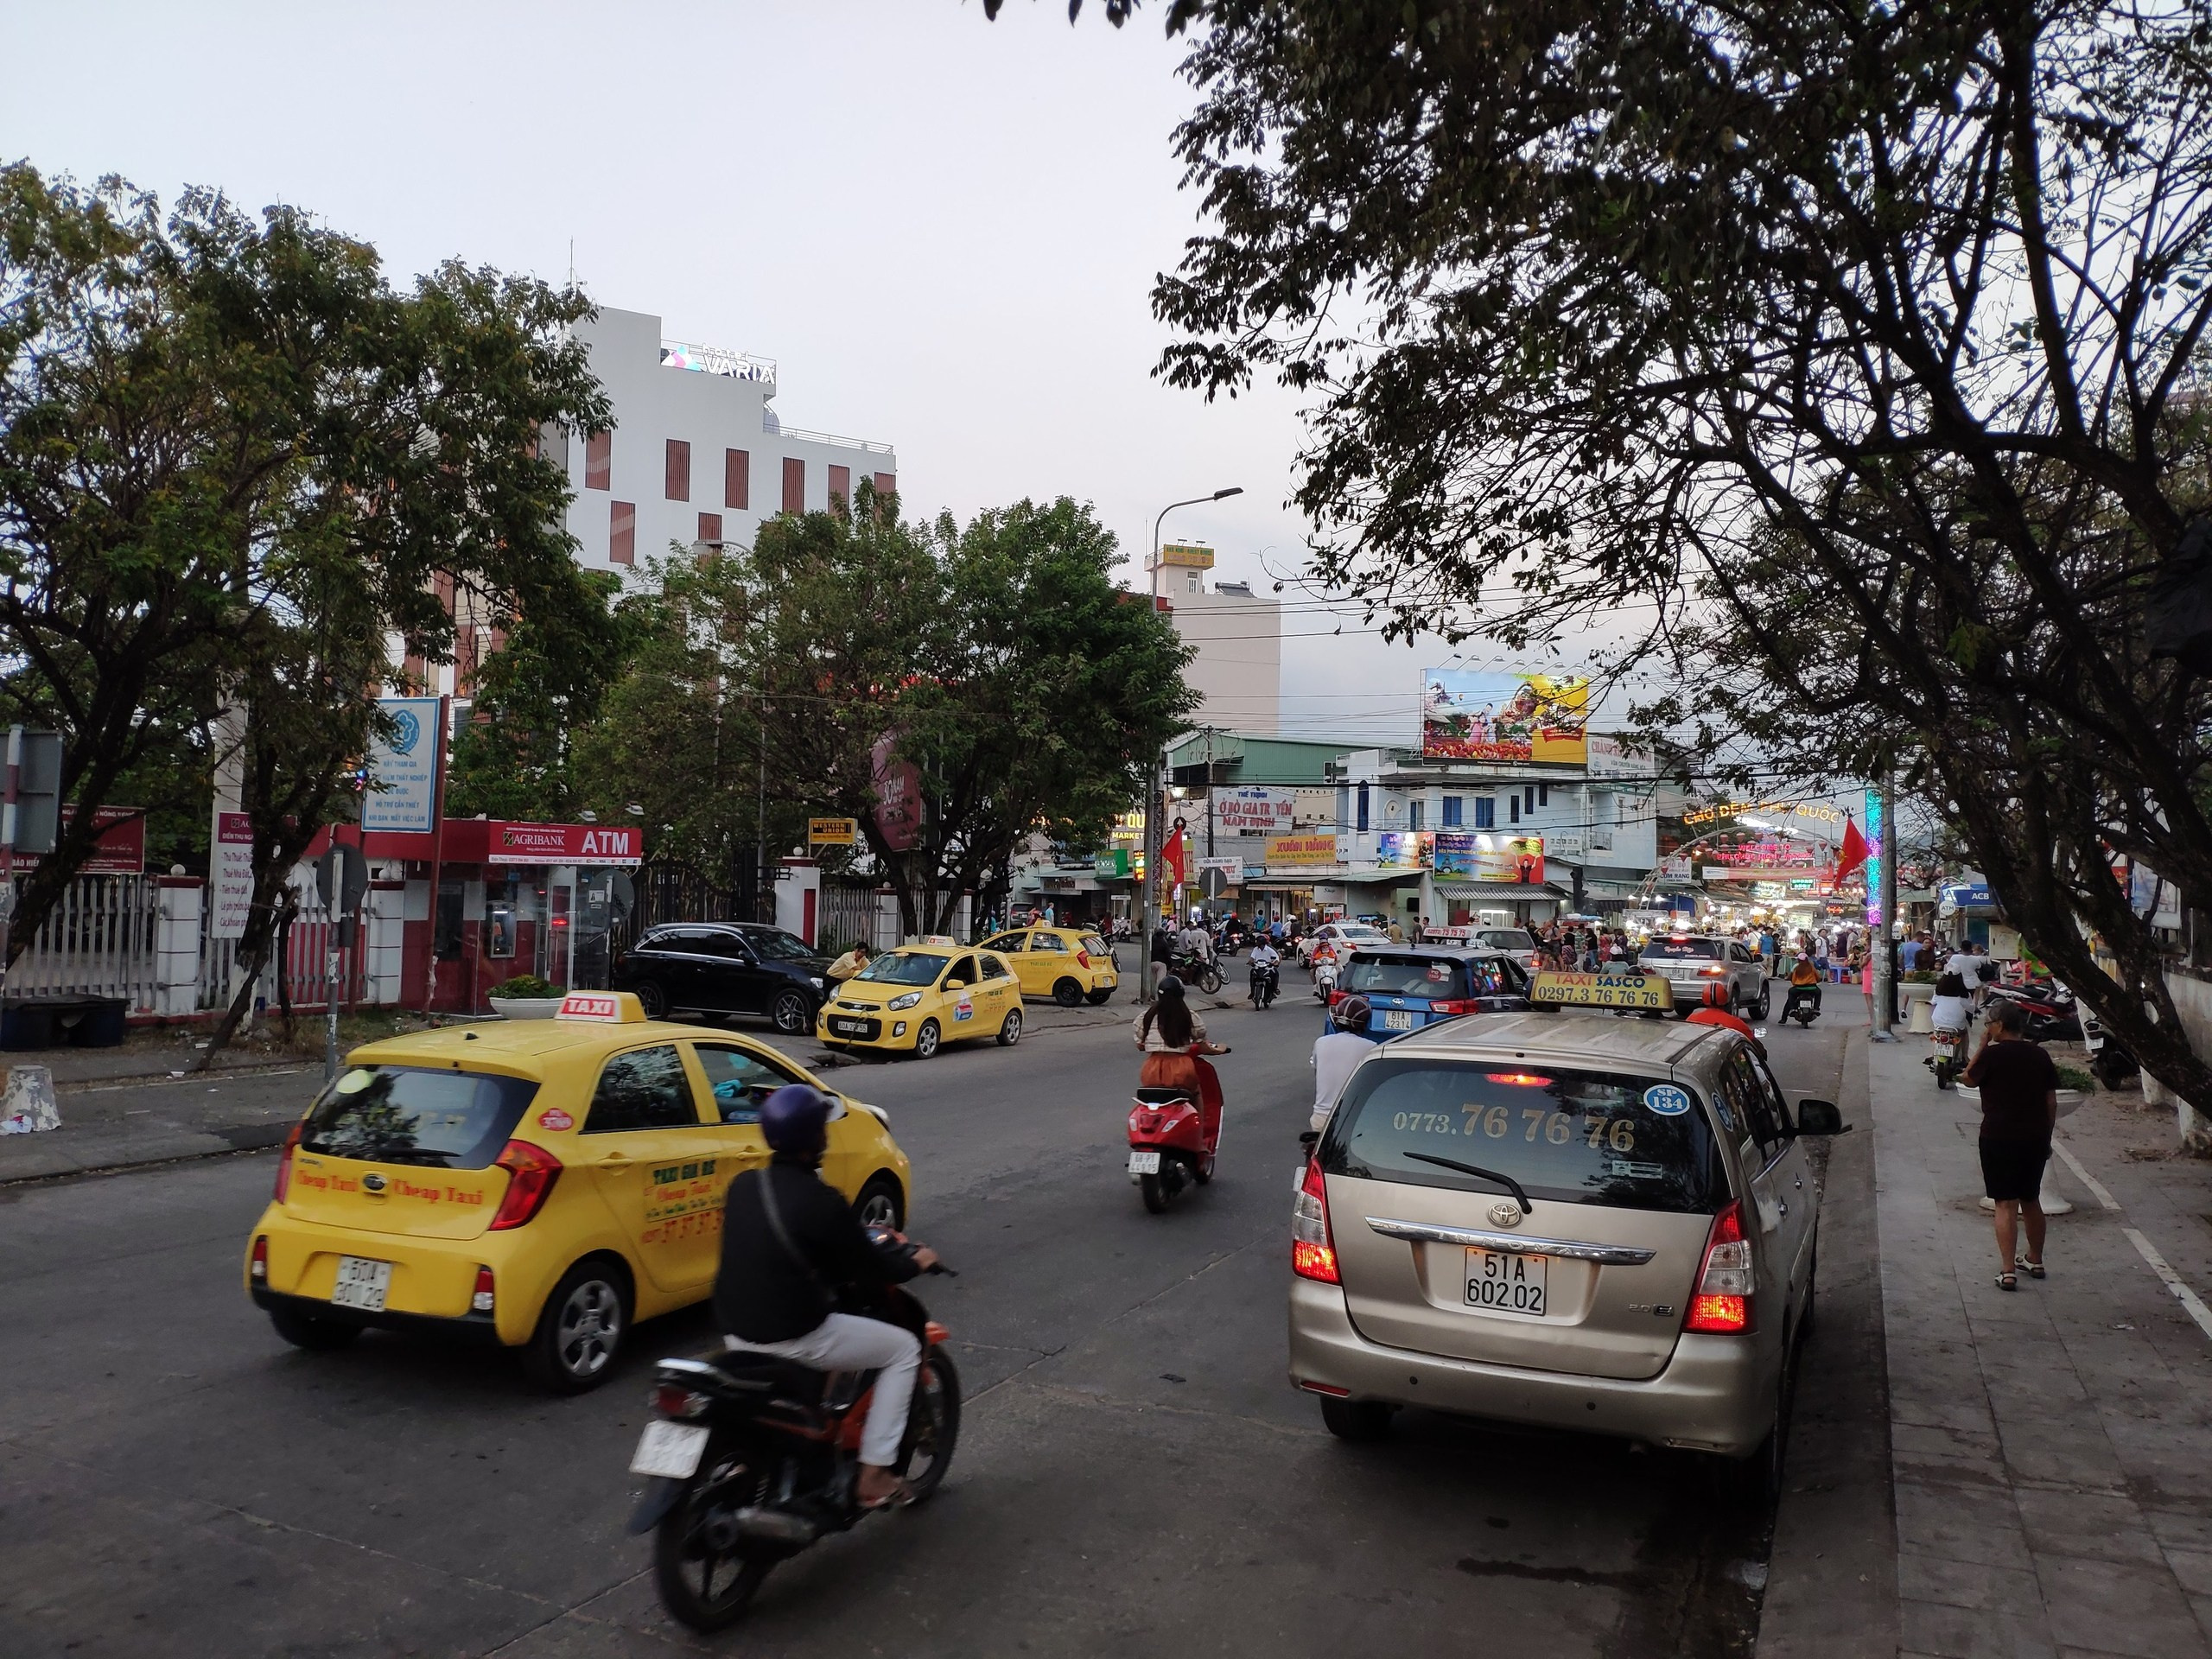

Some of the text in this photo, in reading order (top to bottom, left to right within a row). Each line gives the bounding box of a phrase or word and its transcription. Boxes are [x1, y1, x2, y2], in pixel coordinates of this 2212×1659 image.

[703, 354, 775, 385] VARIA
[1243, 802, 1258, 815] GIA
[1796, 804, 1841, 823] QUỐC
[1223, 816, 1247, 826] NAM
[513, 834, 565, 846] AGRIBANK
[581, 831, 629, 855] ATM
[1276, 840, 1302, 852] XUÂN
[1556, 975, 1646, 988] TAXI SASCO
[1538, 986, 1659, 1006] 0297.3 76 76 76
[568, 1000, 613, 1014] TAXI
[1391, 1012, 1406, 1020] 61A
[1656, 1088, 1678, 1097] SP
[1652, 1096, 1683, 1110] 134
[1521, 1109, 1570, 1145] 76
[1584, 1116, 1635, 1152] 76
[393, 1179, 442, 1204] Cheap
[446, 1185, 484, 1205] Taxi
[1484, 1254, 1526, 1282] 51A
[1468, 1279, 1542, 1312] 602.02
